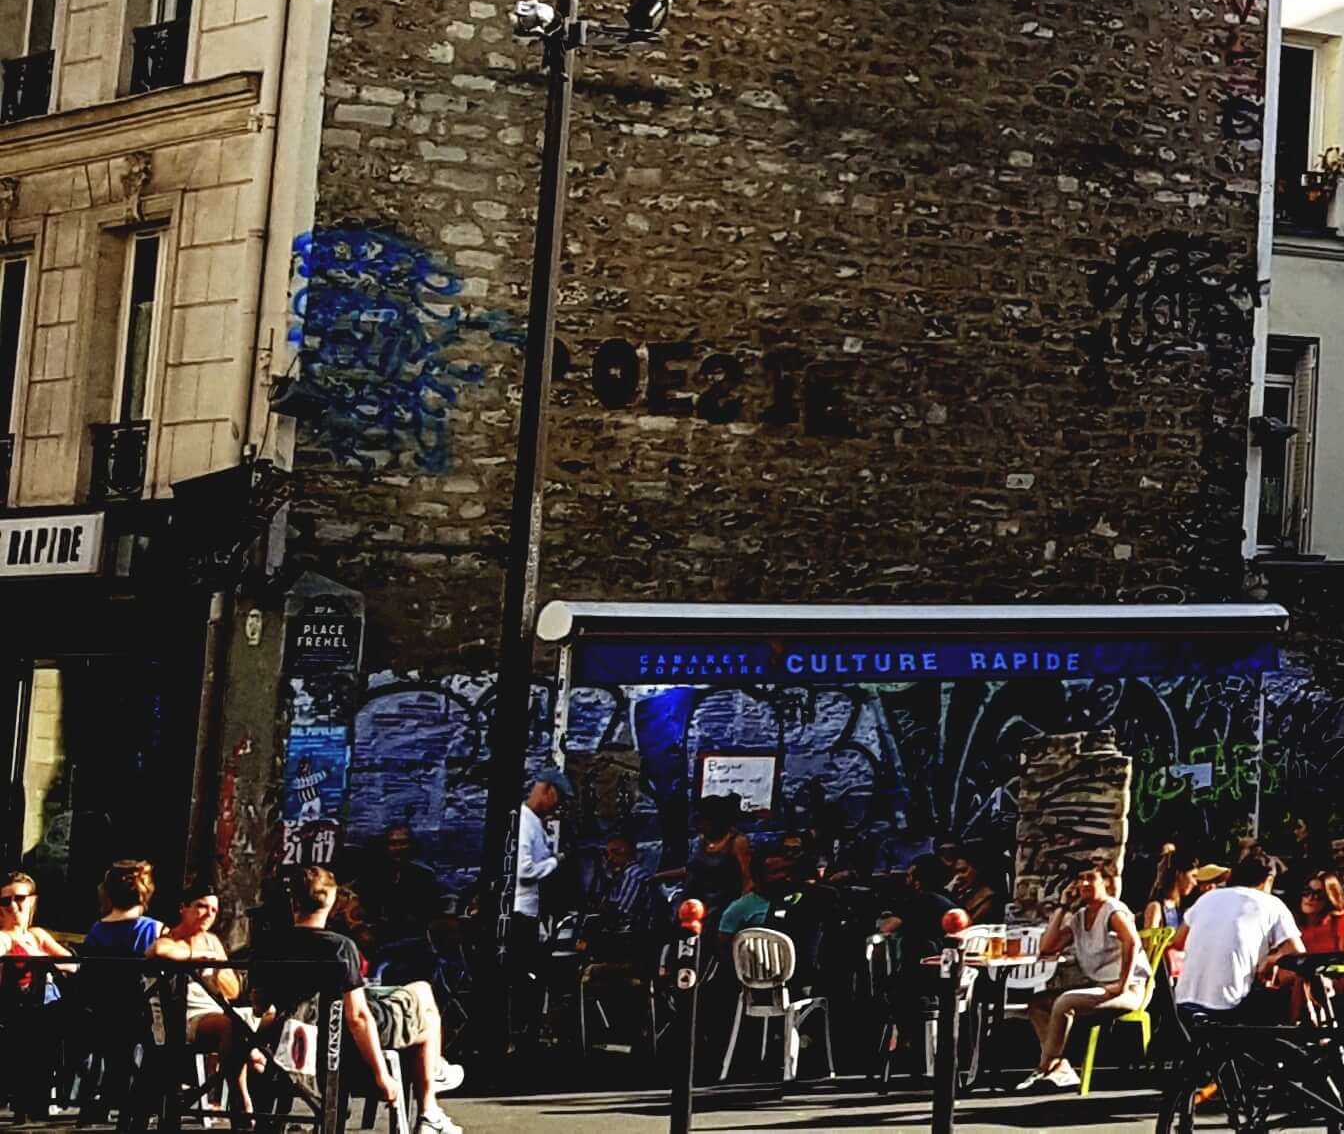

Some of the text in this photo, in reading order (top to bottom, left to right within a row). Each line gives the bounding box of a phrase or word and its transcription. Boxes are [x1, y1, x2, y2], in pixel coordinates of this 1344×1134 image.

[7, 525, 83, 565] RAPIDE
[303, 624, 345, 635] PLACE
[786, 652, 1081, 673] CULTURE RAPIDE
